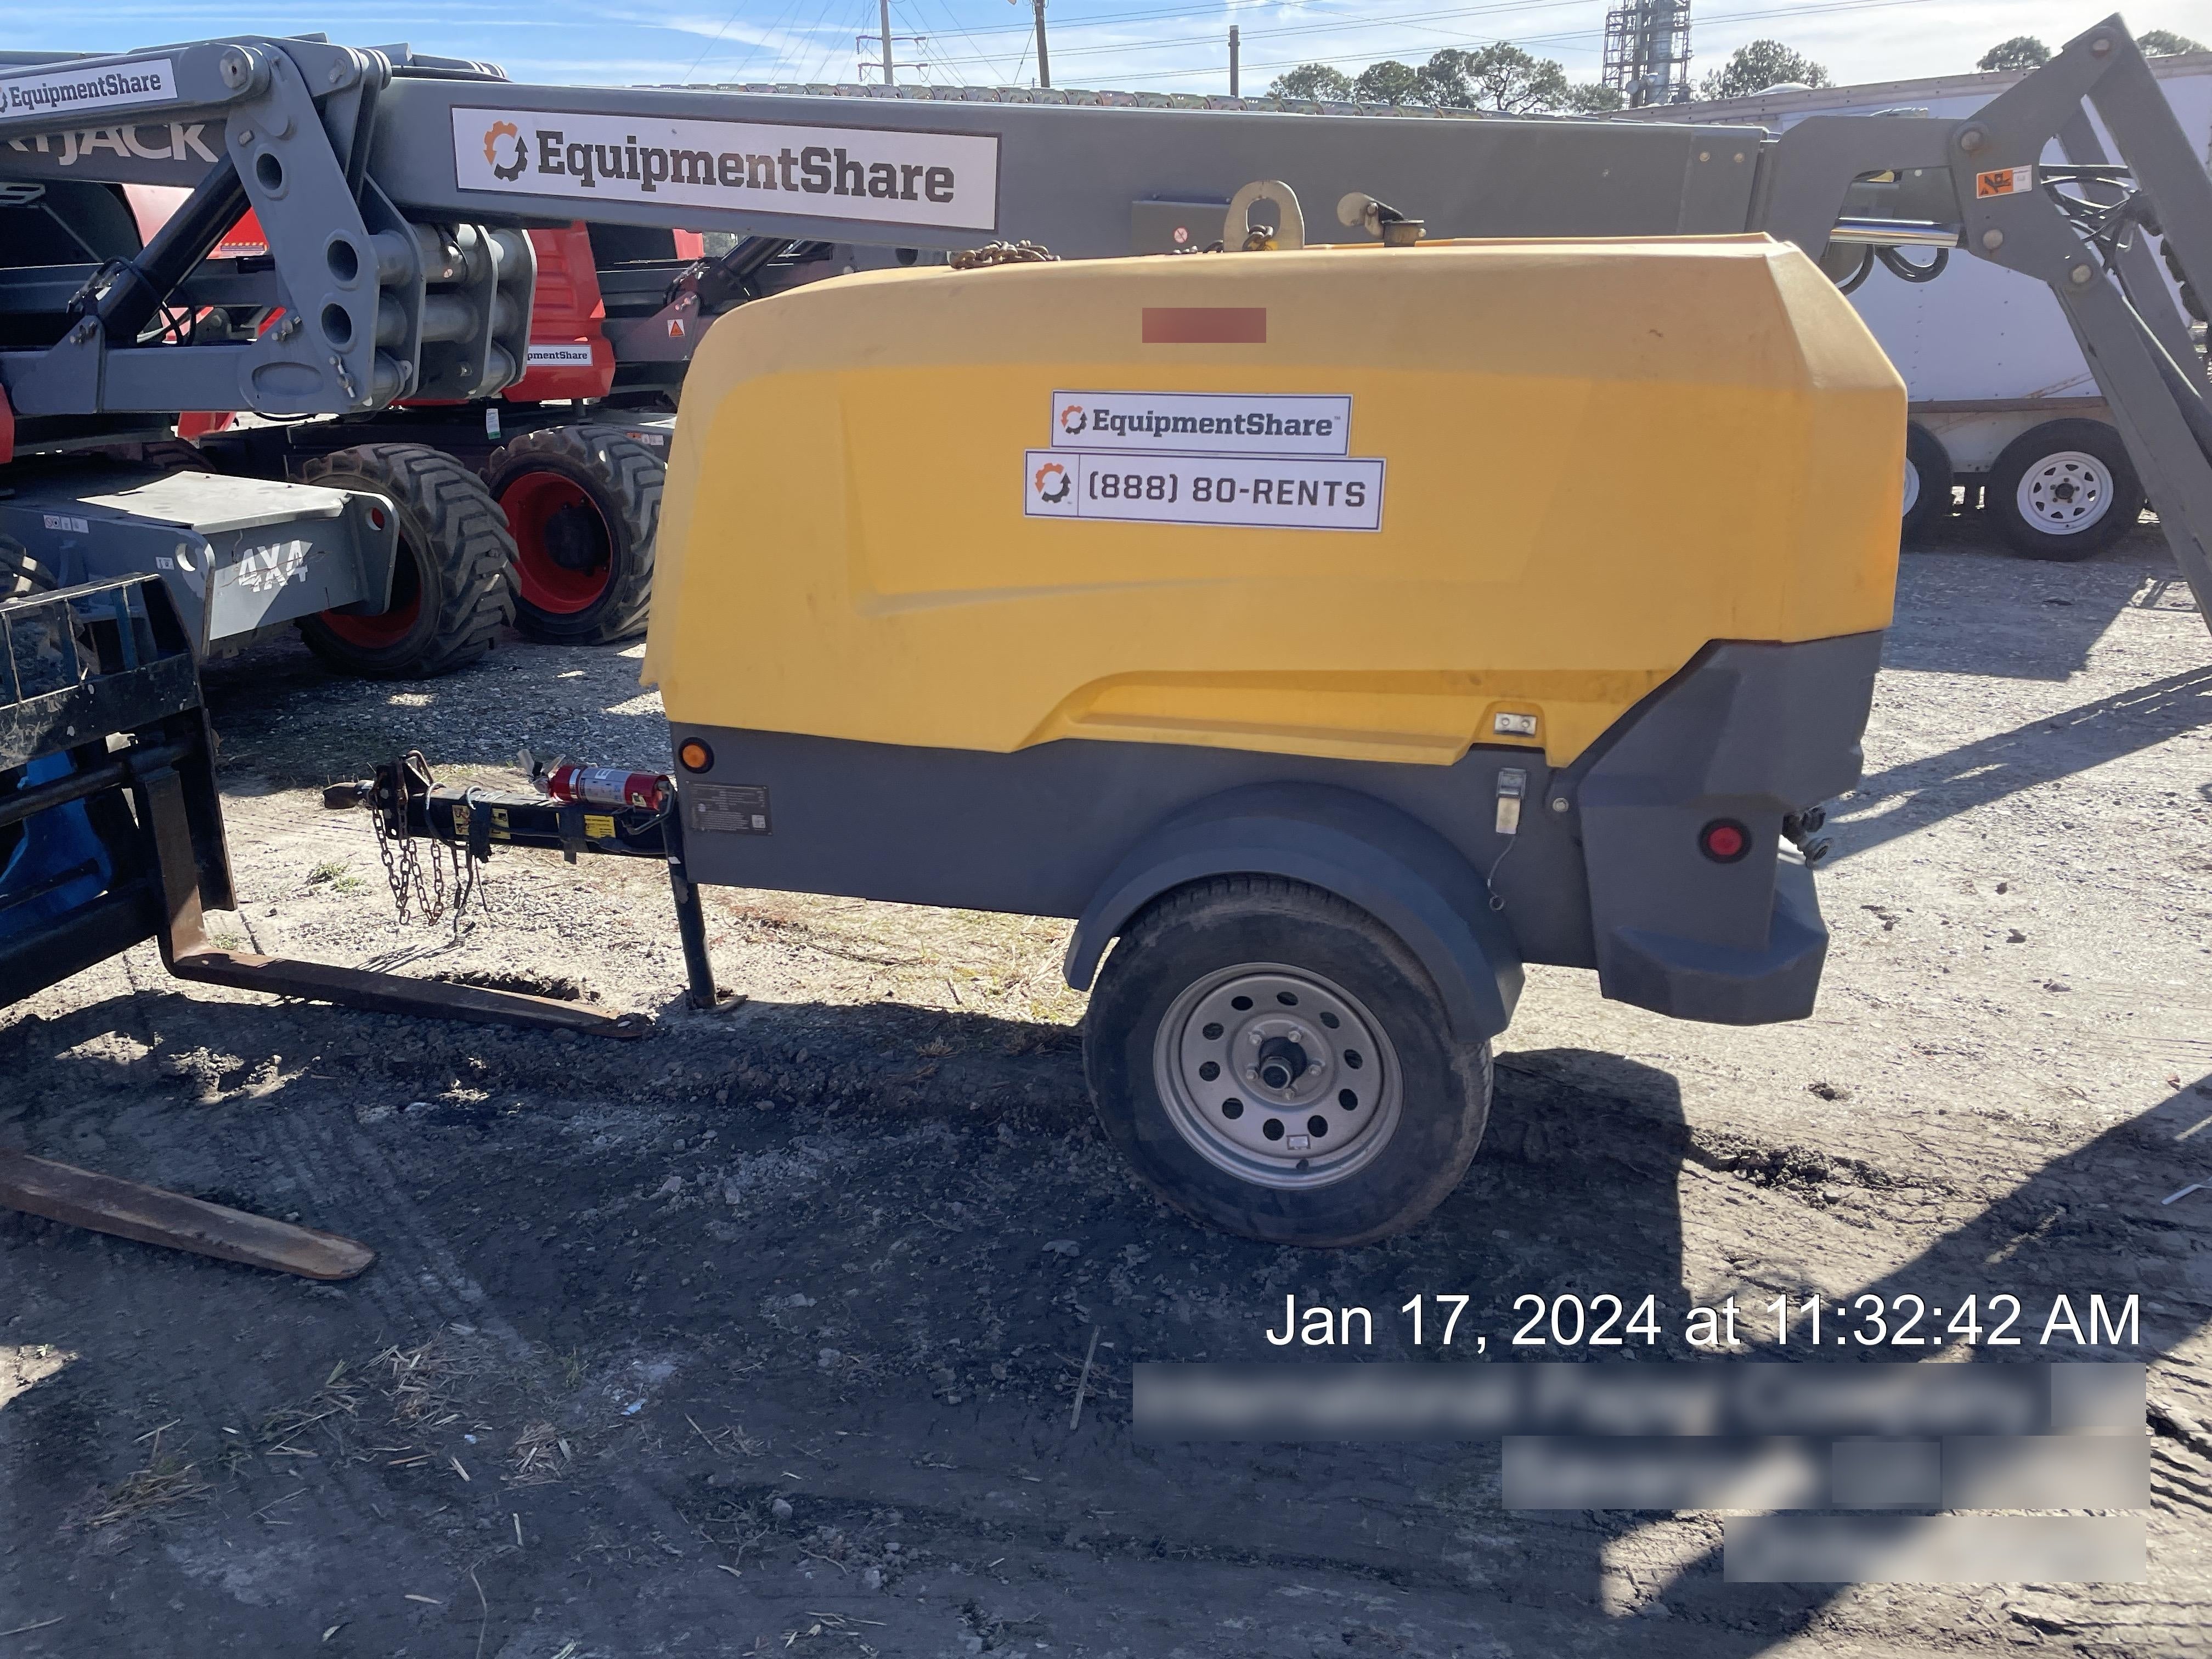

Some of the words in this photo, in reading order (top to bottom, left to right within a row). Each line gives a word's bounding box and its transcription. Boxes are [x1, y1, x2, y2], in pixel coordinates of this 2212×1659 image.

[8, 73, 161, 110] EquipmentShare
[8, 122, 219, 167] JACK
[535, 129, 955, 204] EquipmentShare
[527, 351, 588, 361] pmentShare
[1092, 408, 1333, 438] EquipmentShare
[1089, 471, 1178, 503] (888)
[1192, 476, 1366, 508] 80-RENTS
